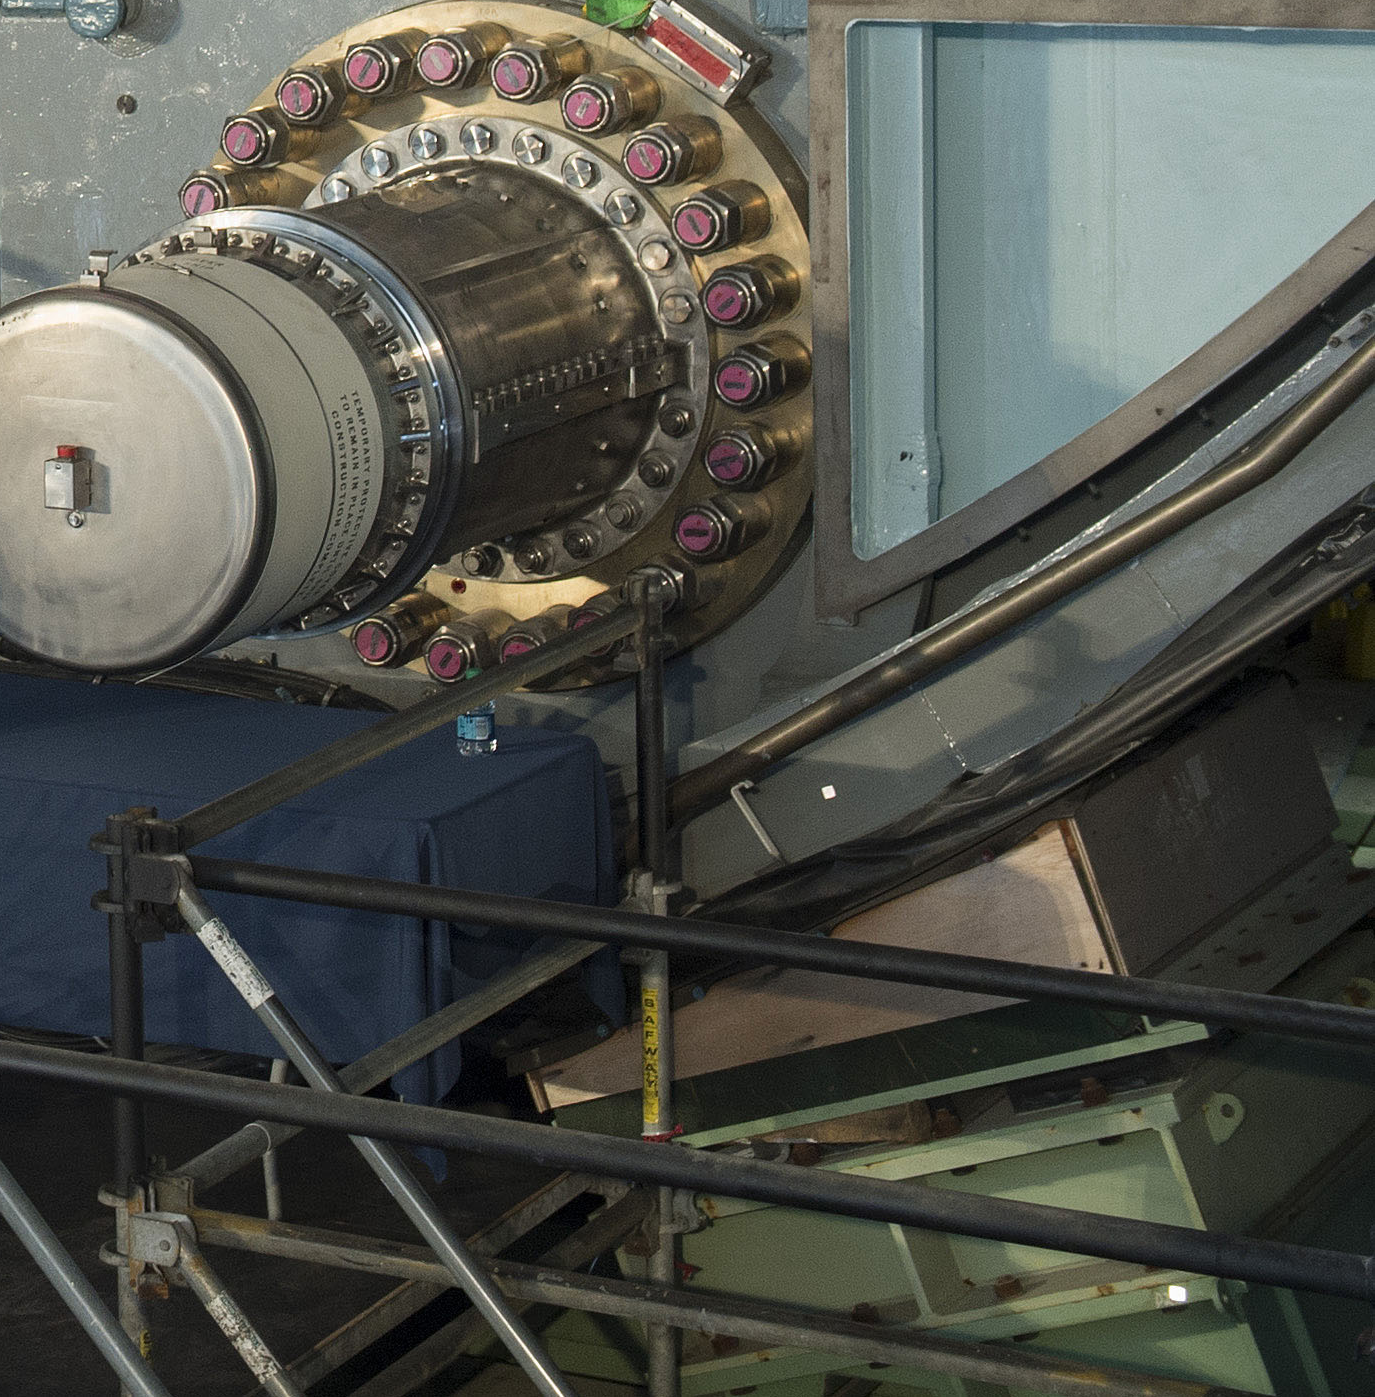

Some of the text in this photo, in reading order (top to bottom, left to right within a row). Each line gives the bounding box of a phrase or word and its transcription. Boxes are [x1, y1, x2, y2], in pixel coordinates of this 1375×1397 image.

[340, 394, 350, 412] TO
[346, 417, 359, 471] REMAIN
[351, 390, 371, 473] TEMPORARY
[332, 410, 348, 527] CONSTRUCTION
[351, 476, 359, 490] IN
[342, 495, 358, 537] PLACE
